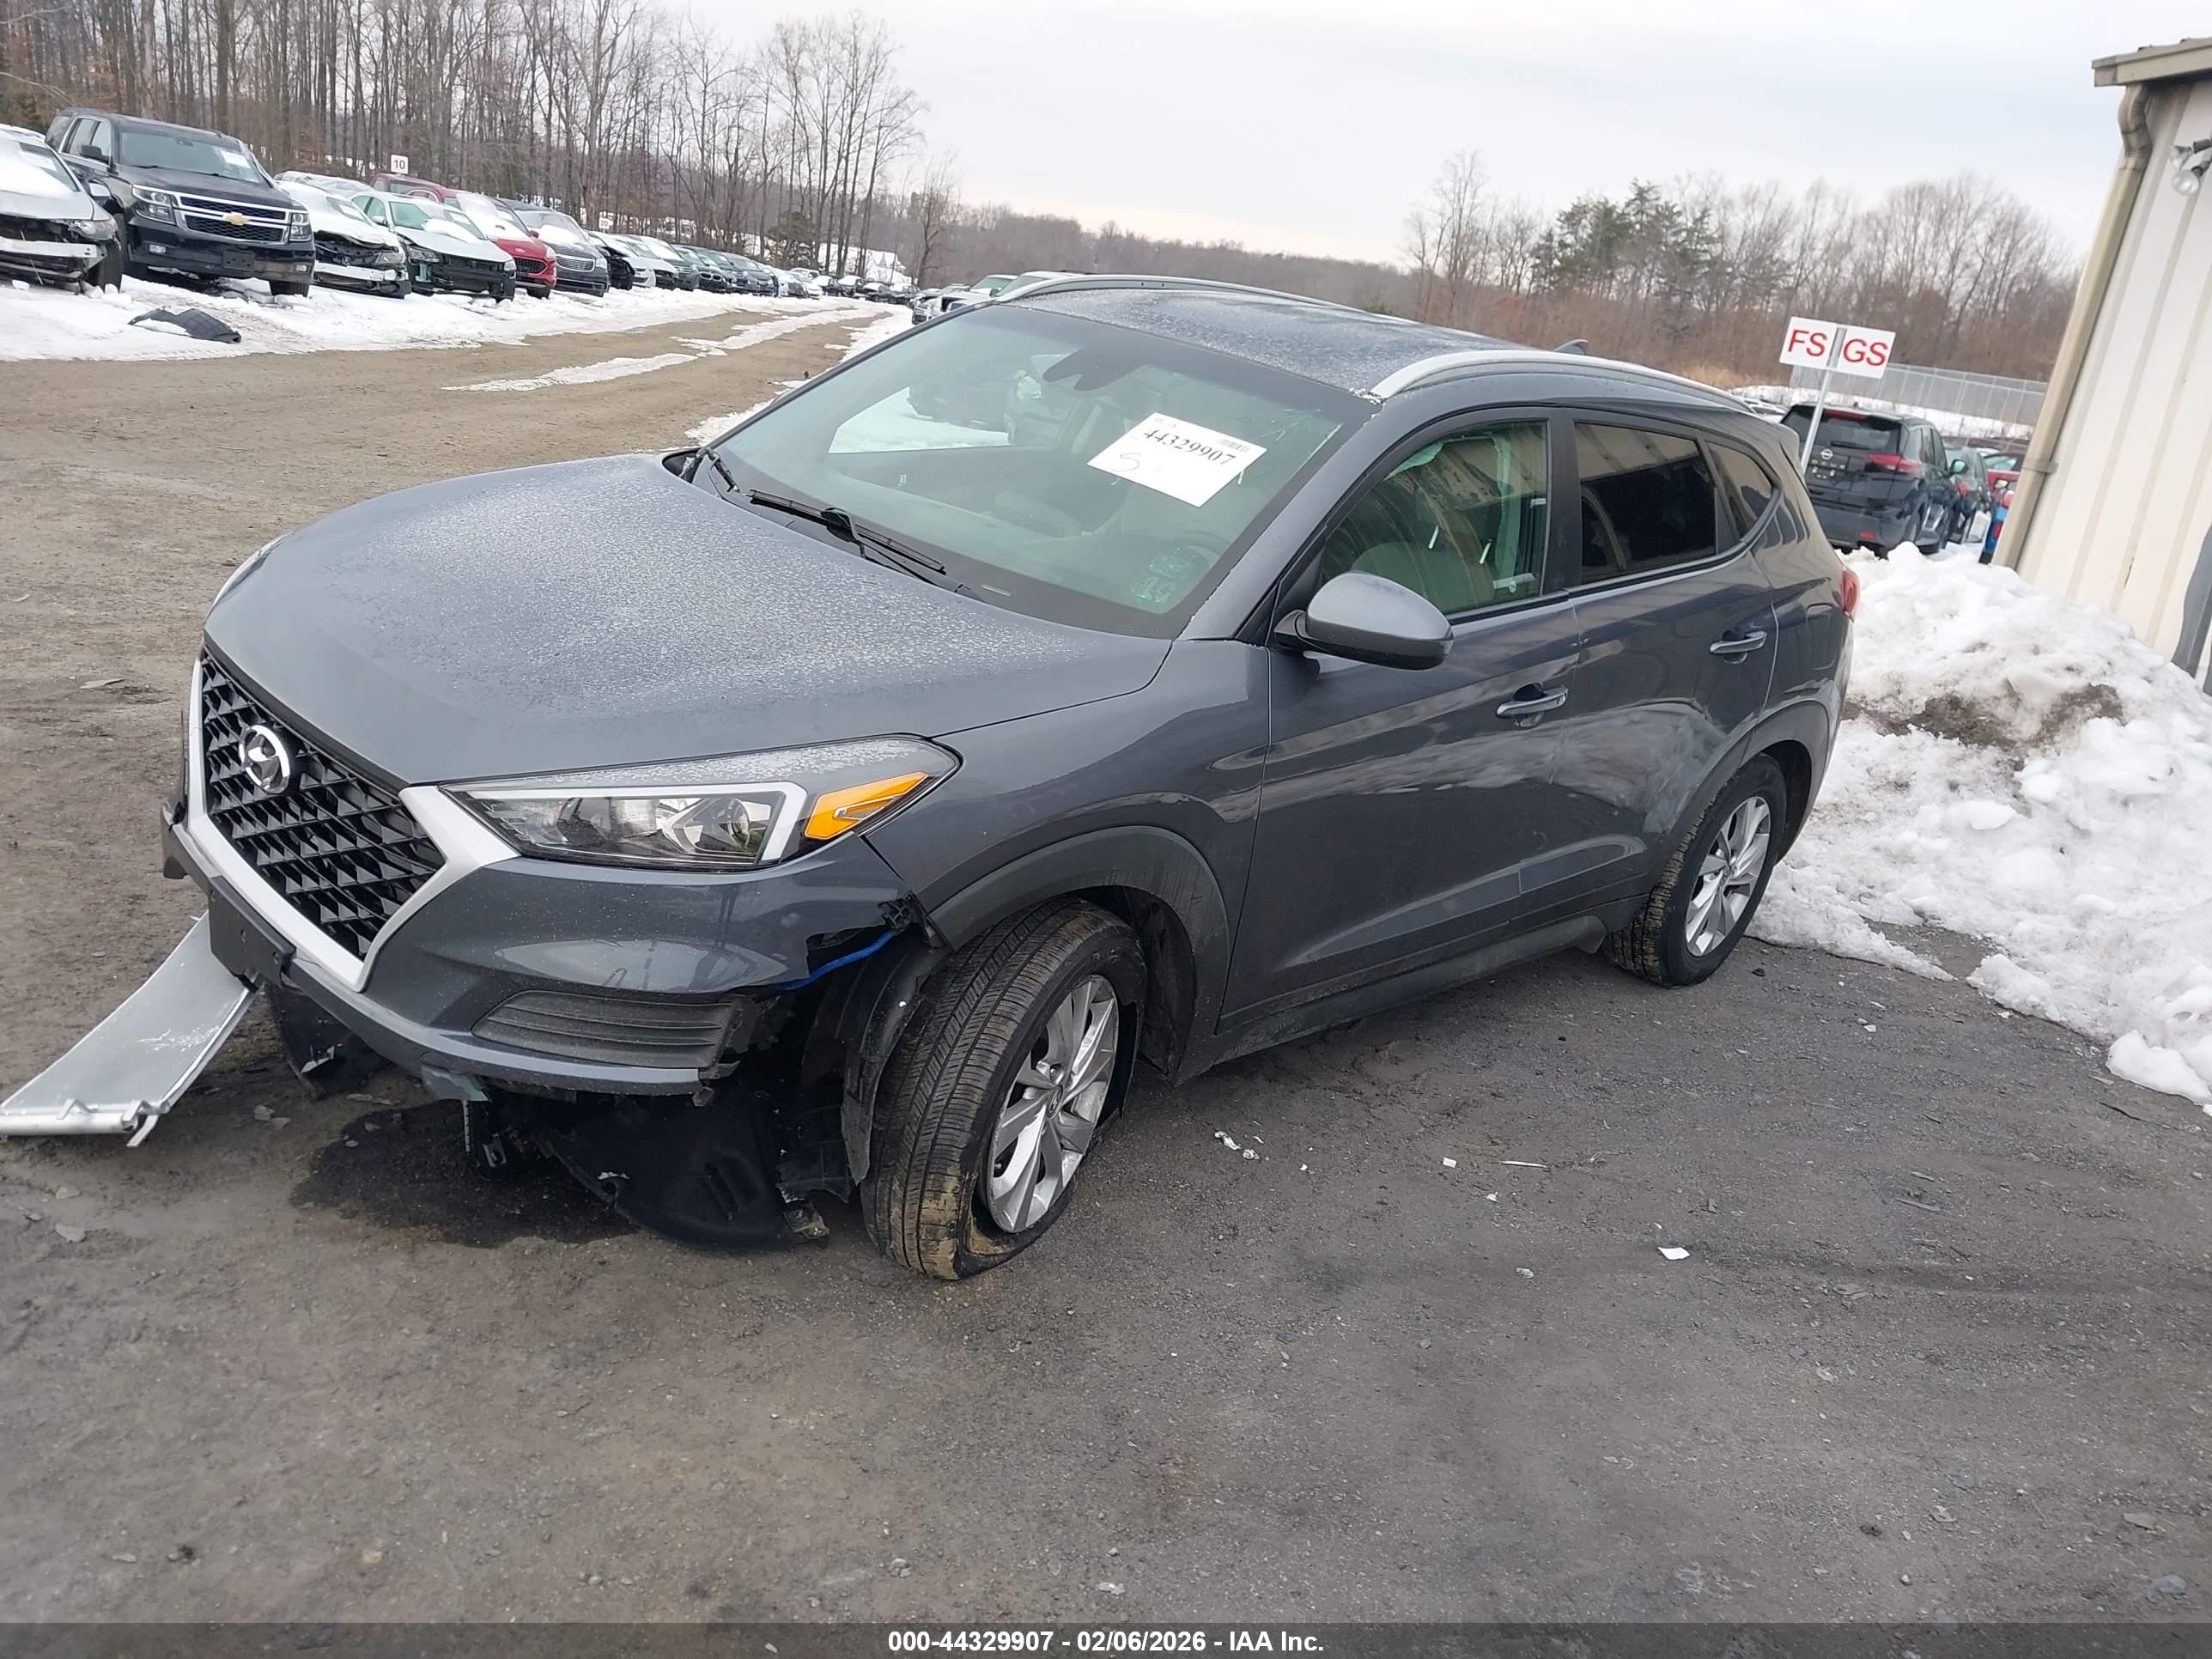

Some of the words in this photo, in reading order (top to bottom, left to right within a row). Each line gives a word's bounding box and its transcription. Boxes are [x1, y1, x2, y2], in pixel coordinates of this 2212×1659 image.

[393, 160, 405, 169] 10
[1787, 329, 1827, 356] FS
[1843, 338, 1888, 366] GS
[1144, 429, 1236, 465] 44329907
